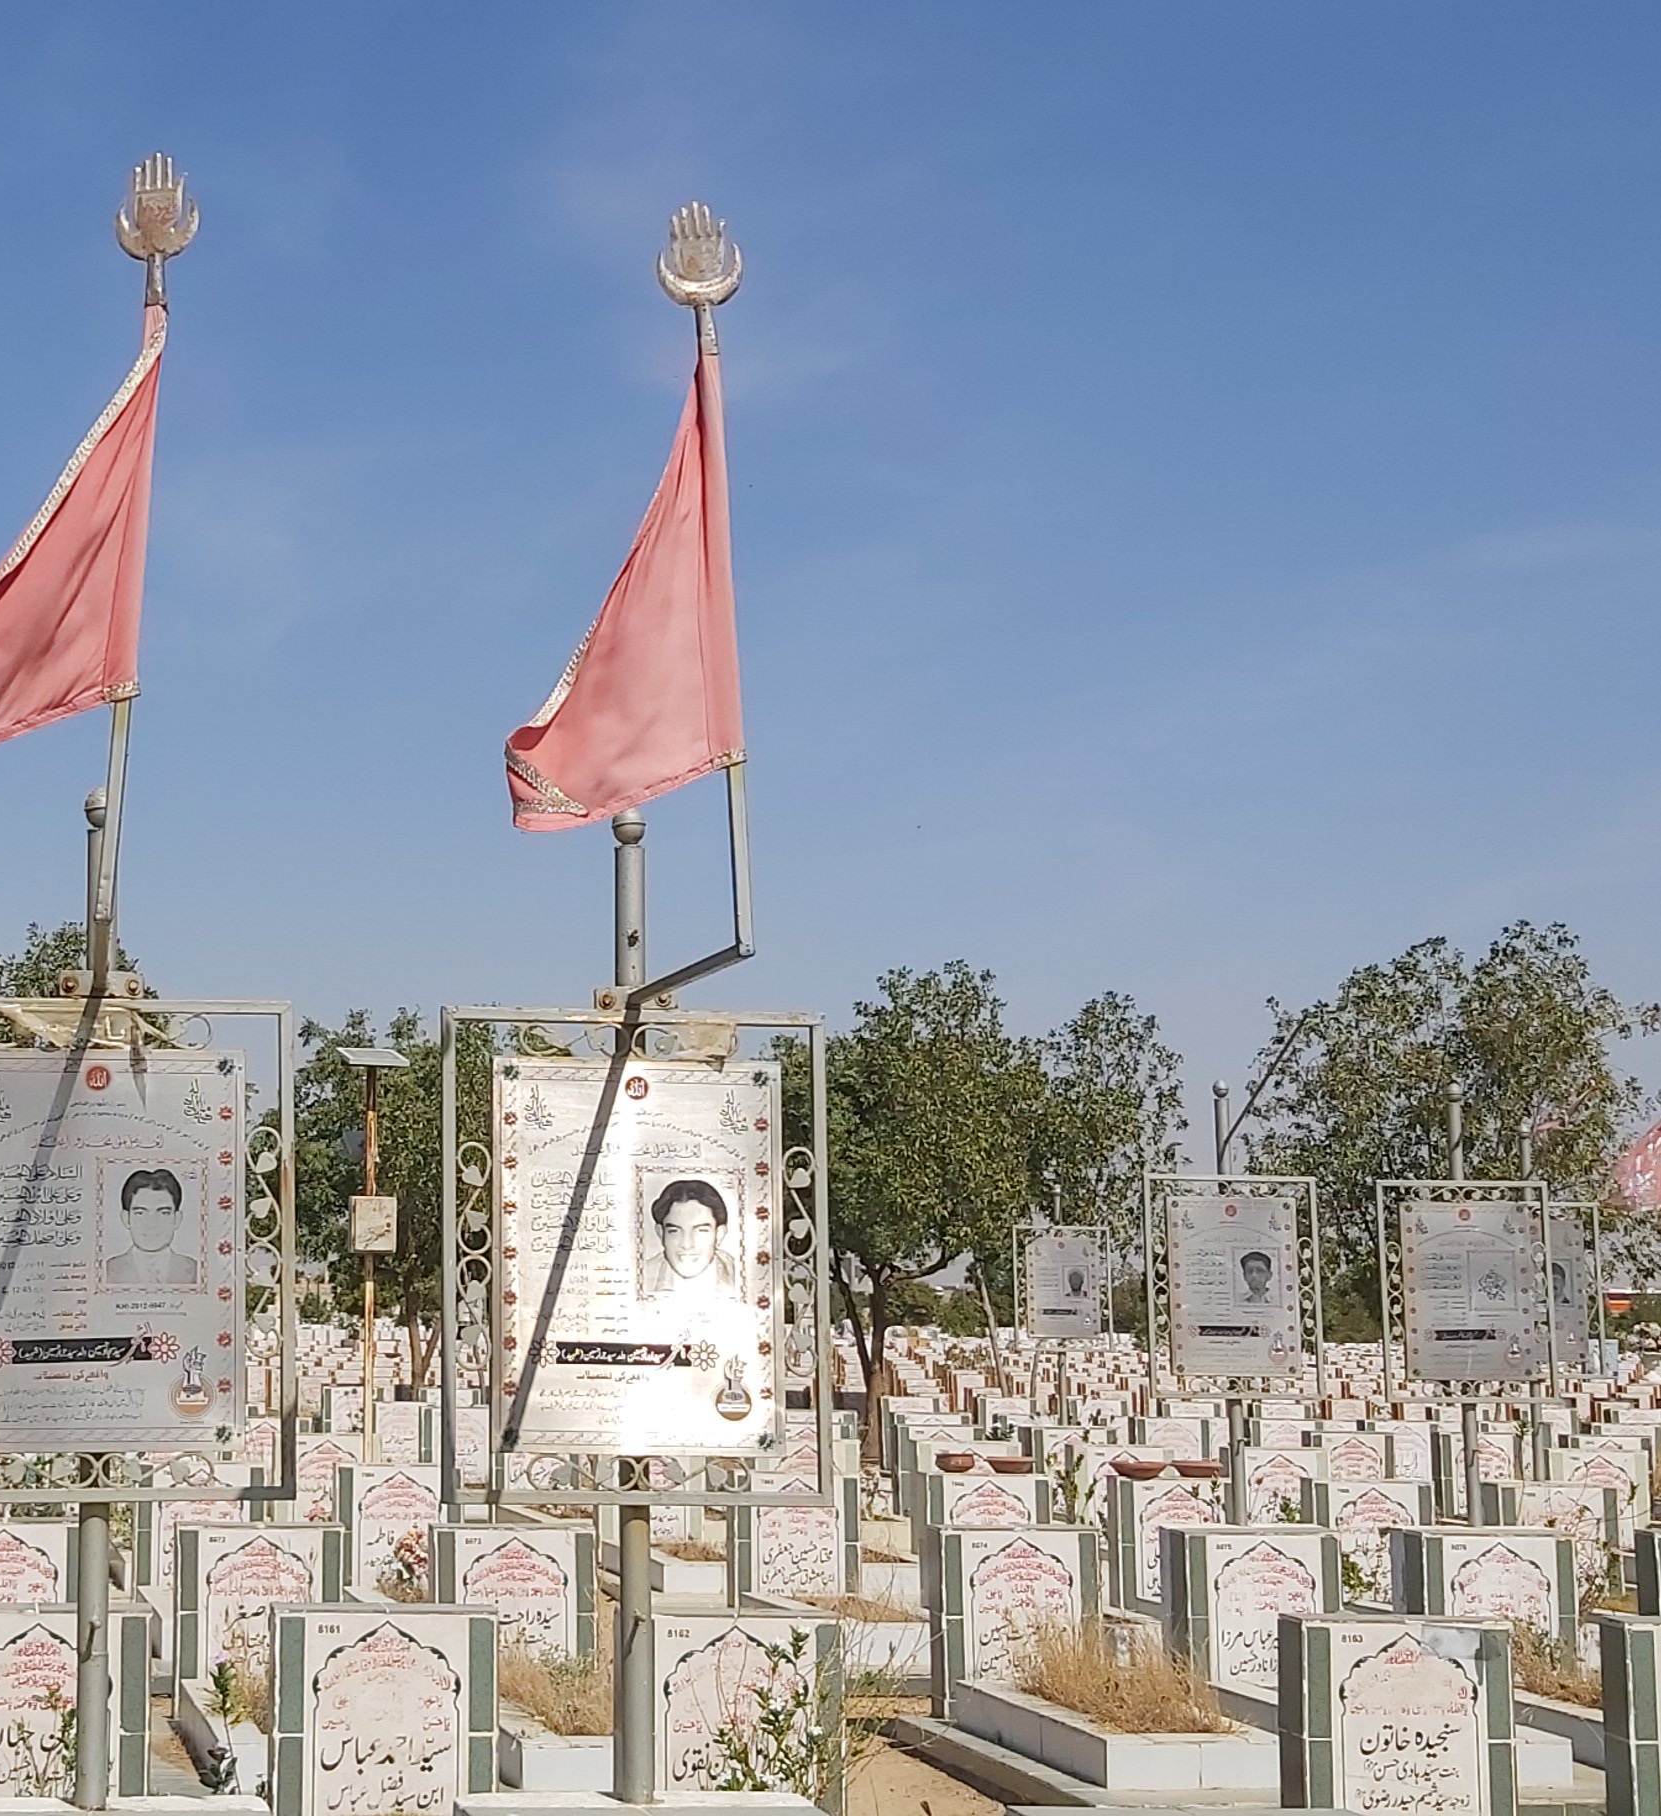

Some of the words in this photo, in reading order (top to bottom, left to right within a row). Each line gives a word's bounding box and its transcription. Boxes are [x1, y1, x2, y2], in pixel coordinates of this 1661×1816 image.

[762, 1542, 795, 1566] جعفری
[791, 1540, 818, 1564] حسین
[317, 1624, 341, 1634] 8161
[666, 1628, 691, 1639] 8162
[1341, 1634, 1364, 1644] 8163
[1359, 1724, 1411, 1756] خاتون
[1416, 1723, 1462, 1759] سنجیدہ
[320, 1736, 382, 1776] عباس
[672, 1742, 710, 1782] نقوی
[1373, 1758, 1400, 1782] حسن
[1438, 1767, 1461, 1779] بنت
[416, 1786, 445, 1810] ابن
[1448, 1793, 1471, 1811] زوجہ
